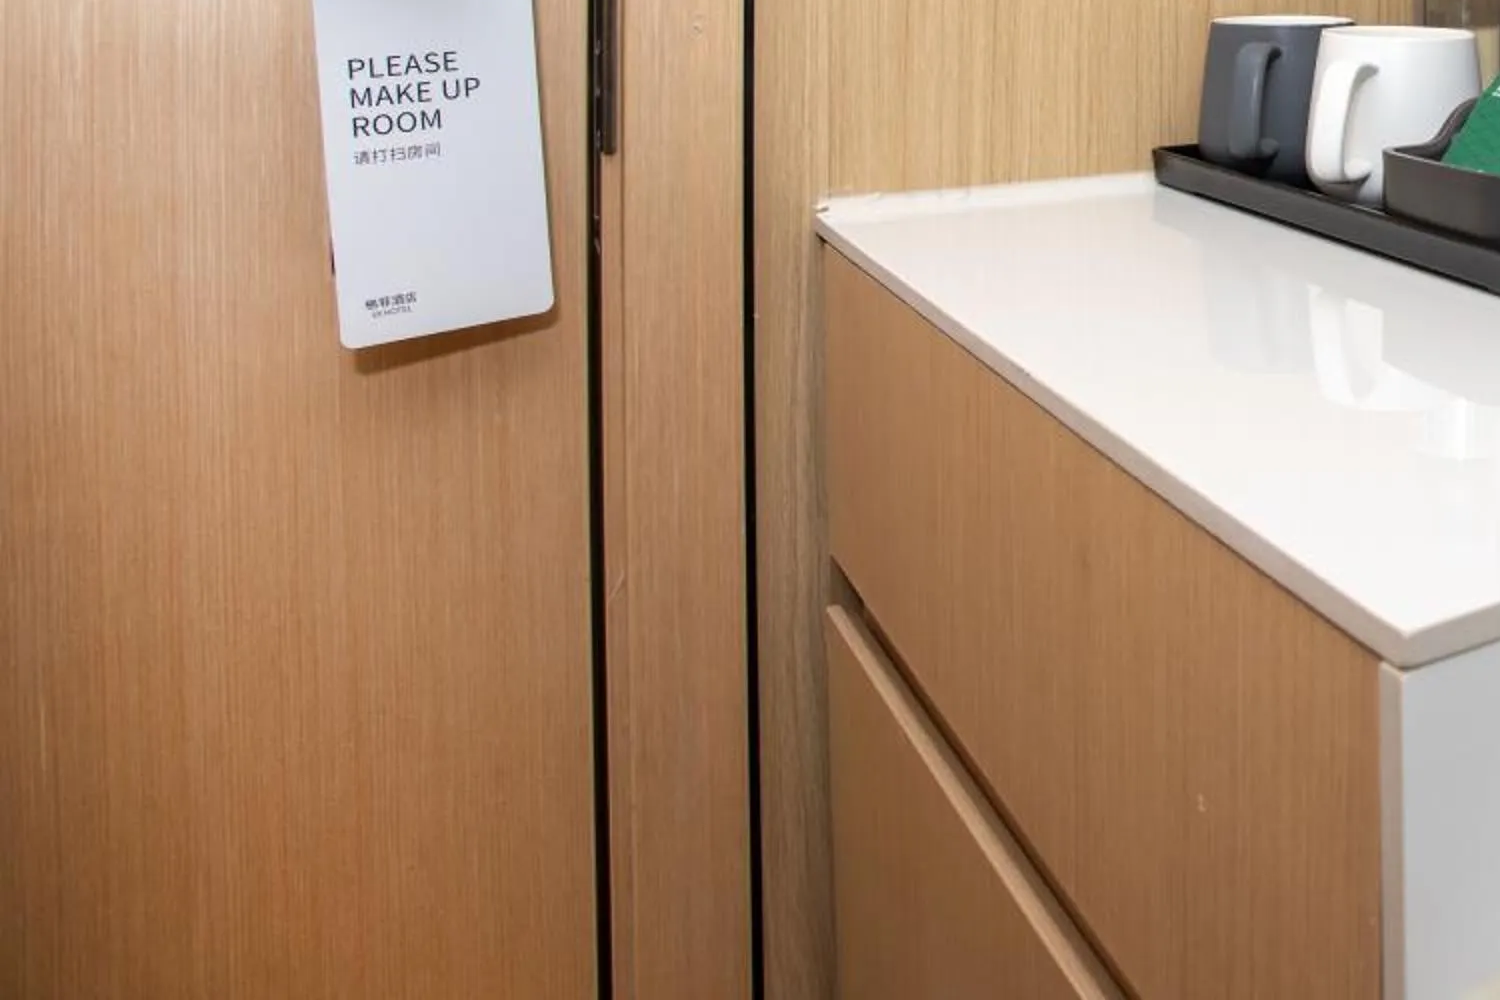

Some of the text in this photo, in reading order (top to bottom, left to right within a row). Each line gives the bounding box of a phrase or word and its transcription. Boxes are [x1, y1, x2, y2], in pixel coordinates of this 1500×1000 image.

[347, 50, 460, 80] PLEASE
[349, 77, 481, 109] MAKE UP
[352, 109, 443, 138] ROOM
[353, 141, 442, 166] 请打扫房间
